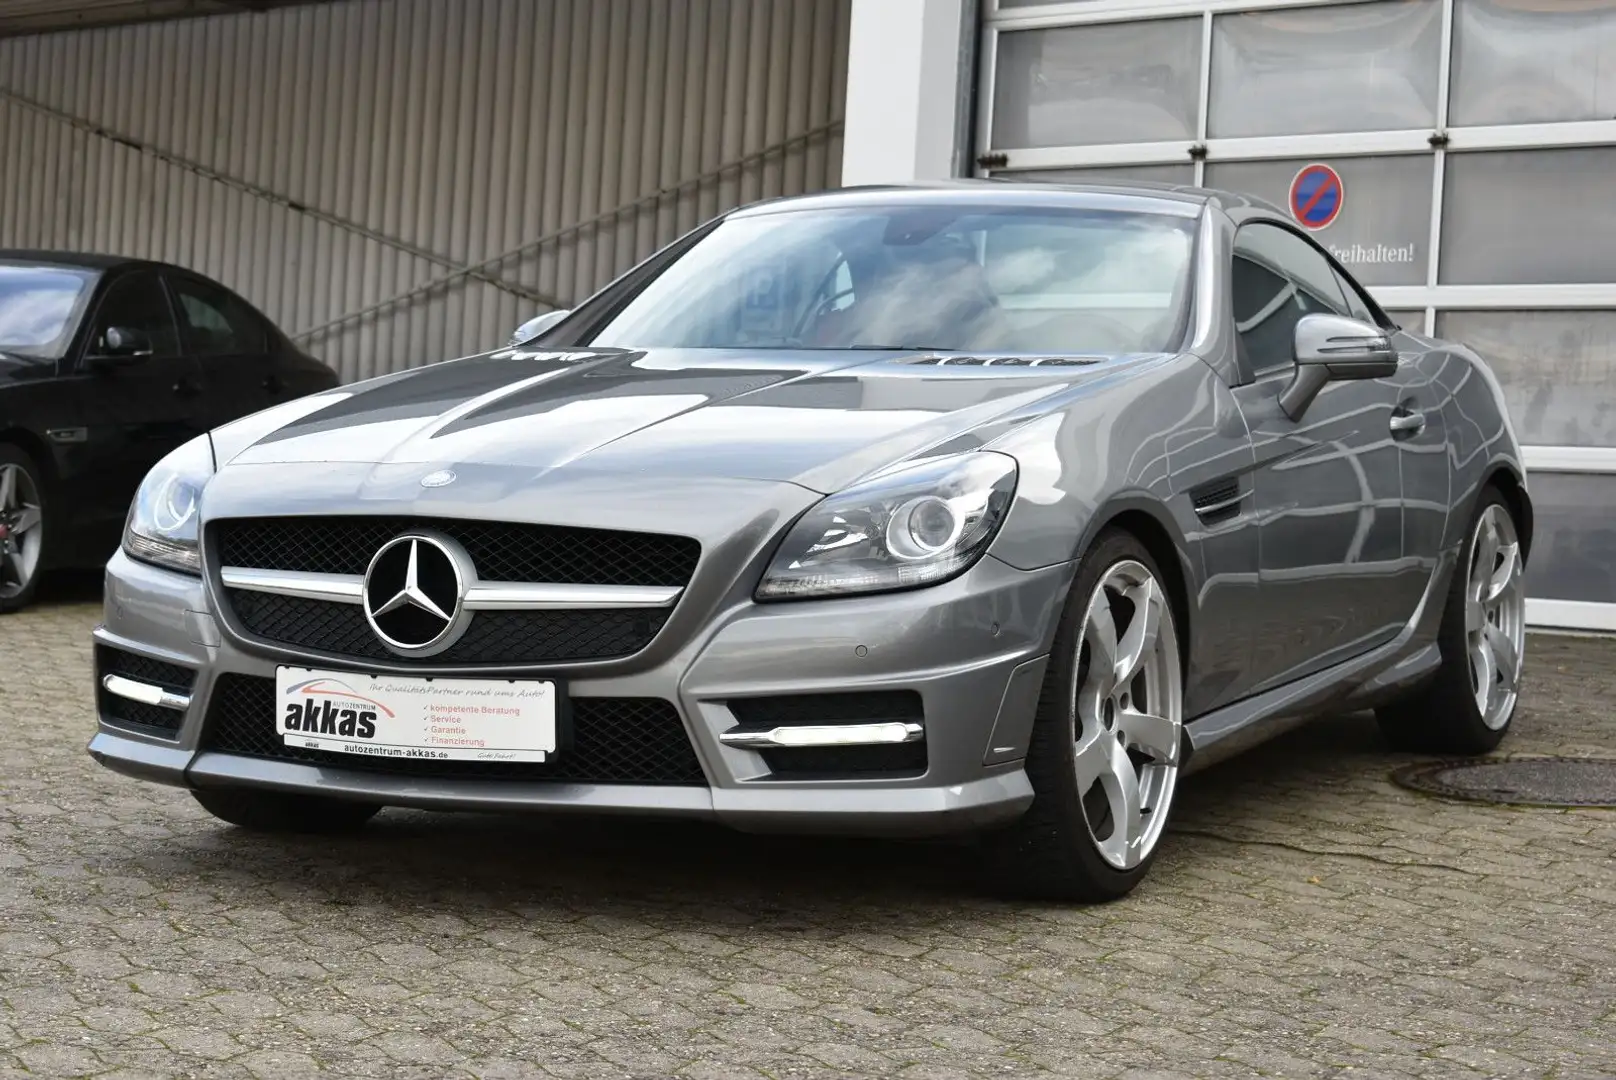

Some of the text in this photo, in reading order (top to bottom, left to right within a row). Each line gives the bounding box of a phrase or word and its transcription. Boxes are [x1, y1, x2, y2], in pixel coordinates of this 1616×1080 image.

[465, 688, 492, 697] rund
[332, 701, 376, 711] AUTOZENTRUM
[430, 704, 520, 716] kompetente Beratung
[284, 698, 377, 738] akkas
[431, 714, 461, 724] Service
[431, 725, 466, 735] Garantie
[431, 736, 485, 747] Finanzierung
[344, 744, 449, 759] autozentrum-akkas.de
